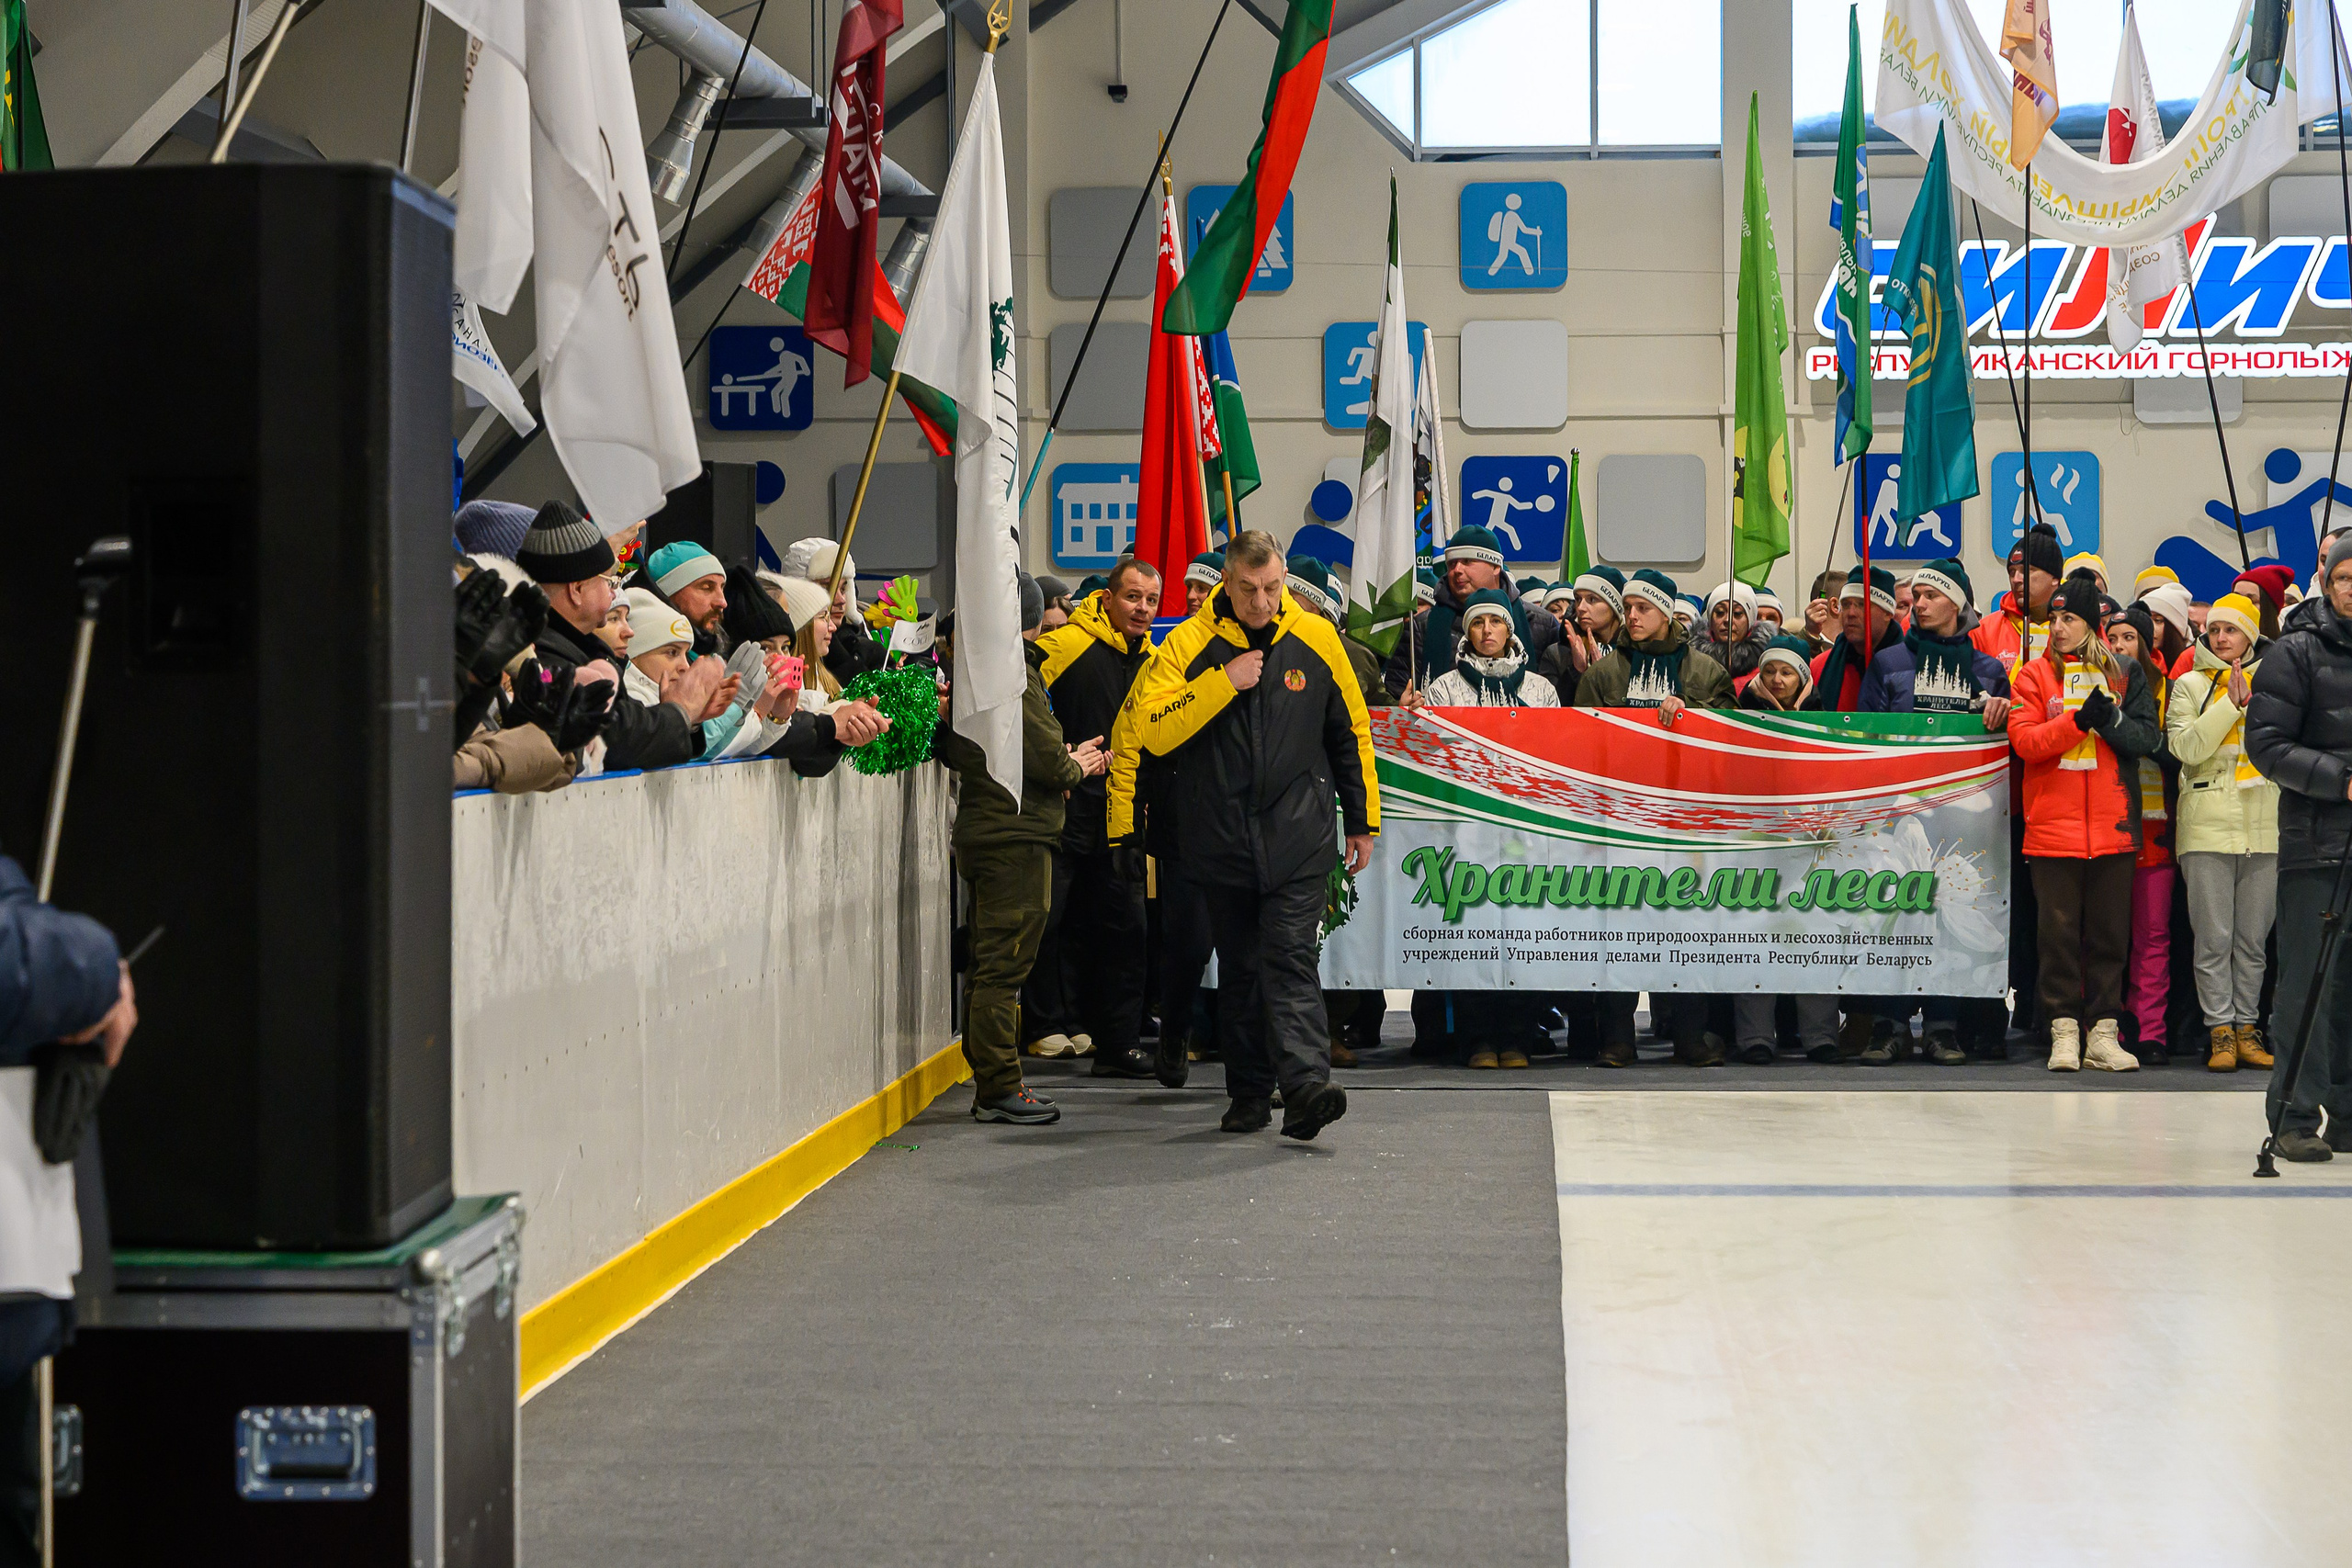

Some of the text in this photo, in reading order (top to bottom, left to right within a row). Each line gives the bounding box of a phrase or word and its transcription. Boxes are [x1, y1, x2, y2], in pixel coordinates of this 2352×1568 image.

[1401, 845, 1936, 922] Хранители леса
[1402, 925, 1933, 945] сборная команда работников природоохранных и лесохозяйственных
[1402, 946, 1933, 969] учреждений Управления делами Президента Республики Беларусь
